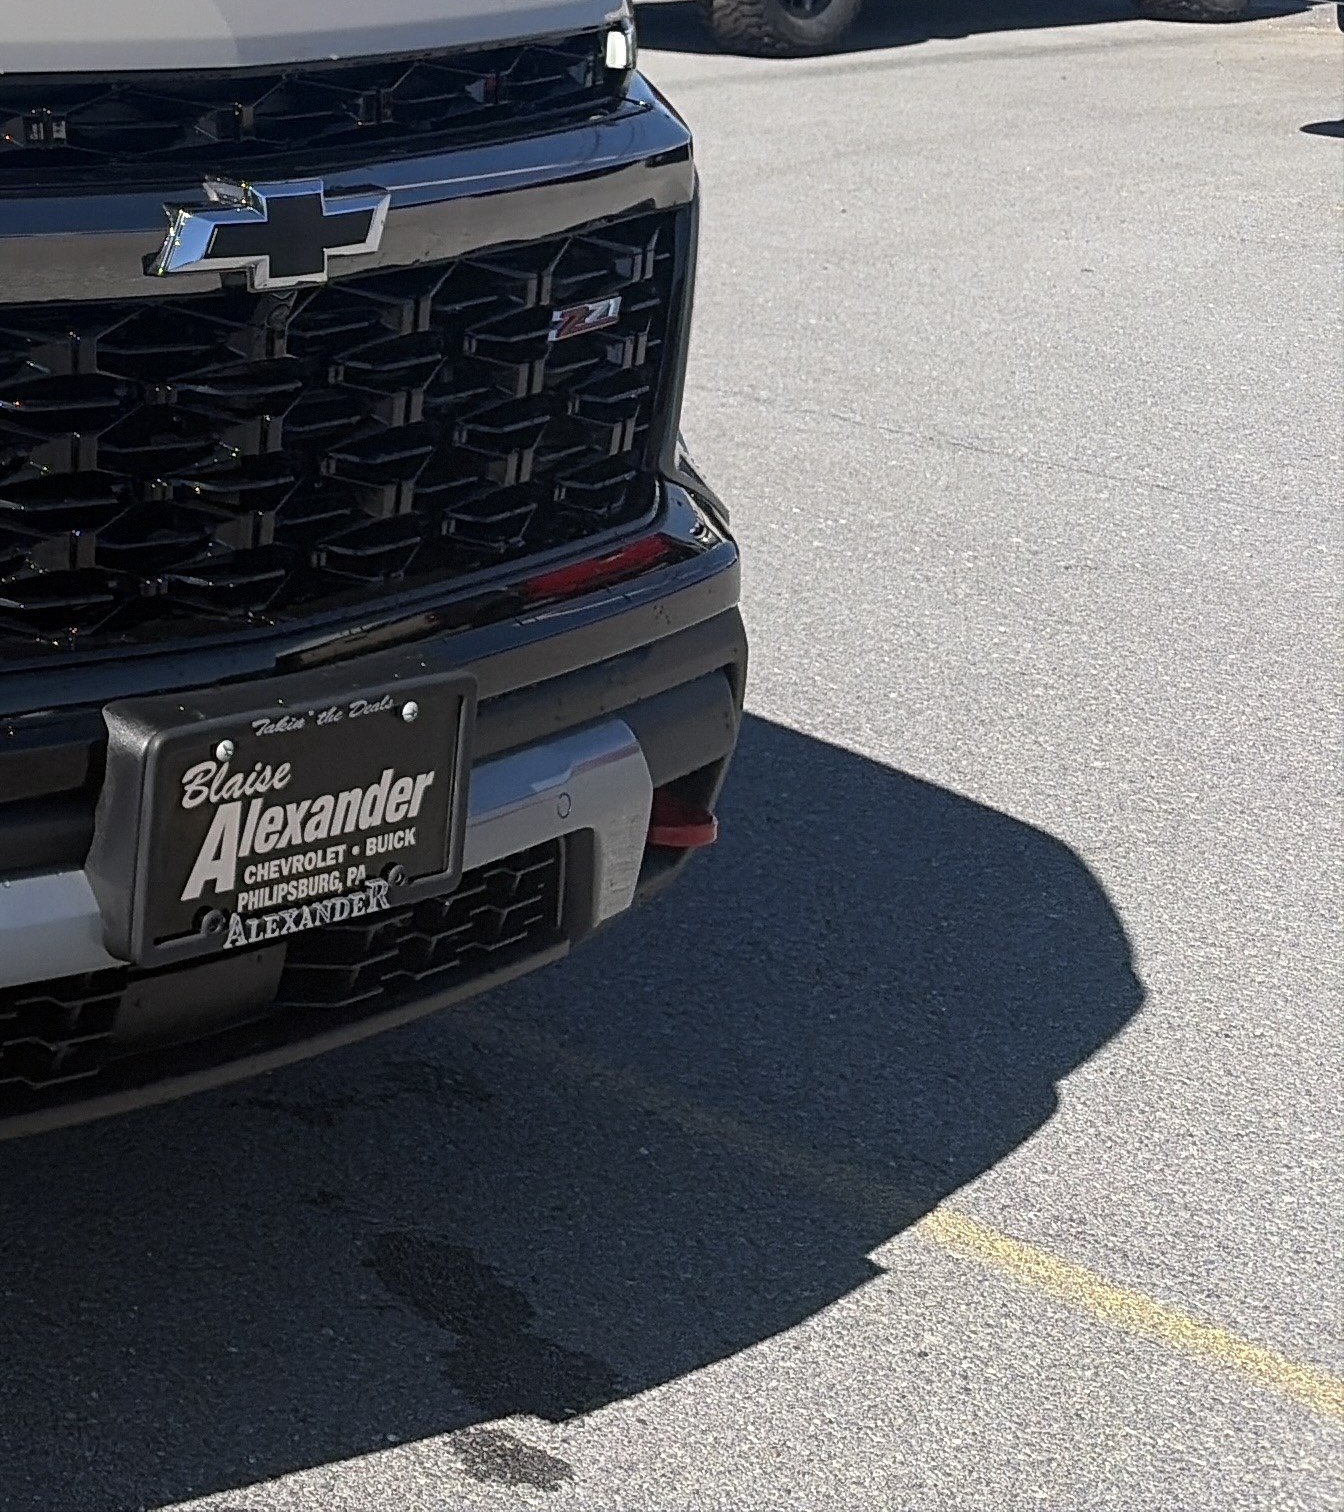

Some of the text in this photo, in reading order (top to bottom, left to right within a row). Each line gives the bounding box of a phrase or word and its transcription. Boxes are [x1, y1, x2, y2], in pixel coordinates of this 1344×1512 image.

[316, 705, 344, 726] the
[348, 694, 395, 719] Deals
[180, 760, 292, 809] Blaise
[179, 768, 436, 902] Alexander
[243, 826, 417, 886] CHEVROLET BUICK
[222, 877, 391, 950] ALEXANDER
[236, 864, 368, 914] PHILIPSBURG, PA
